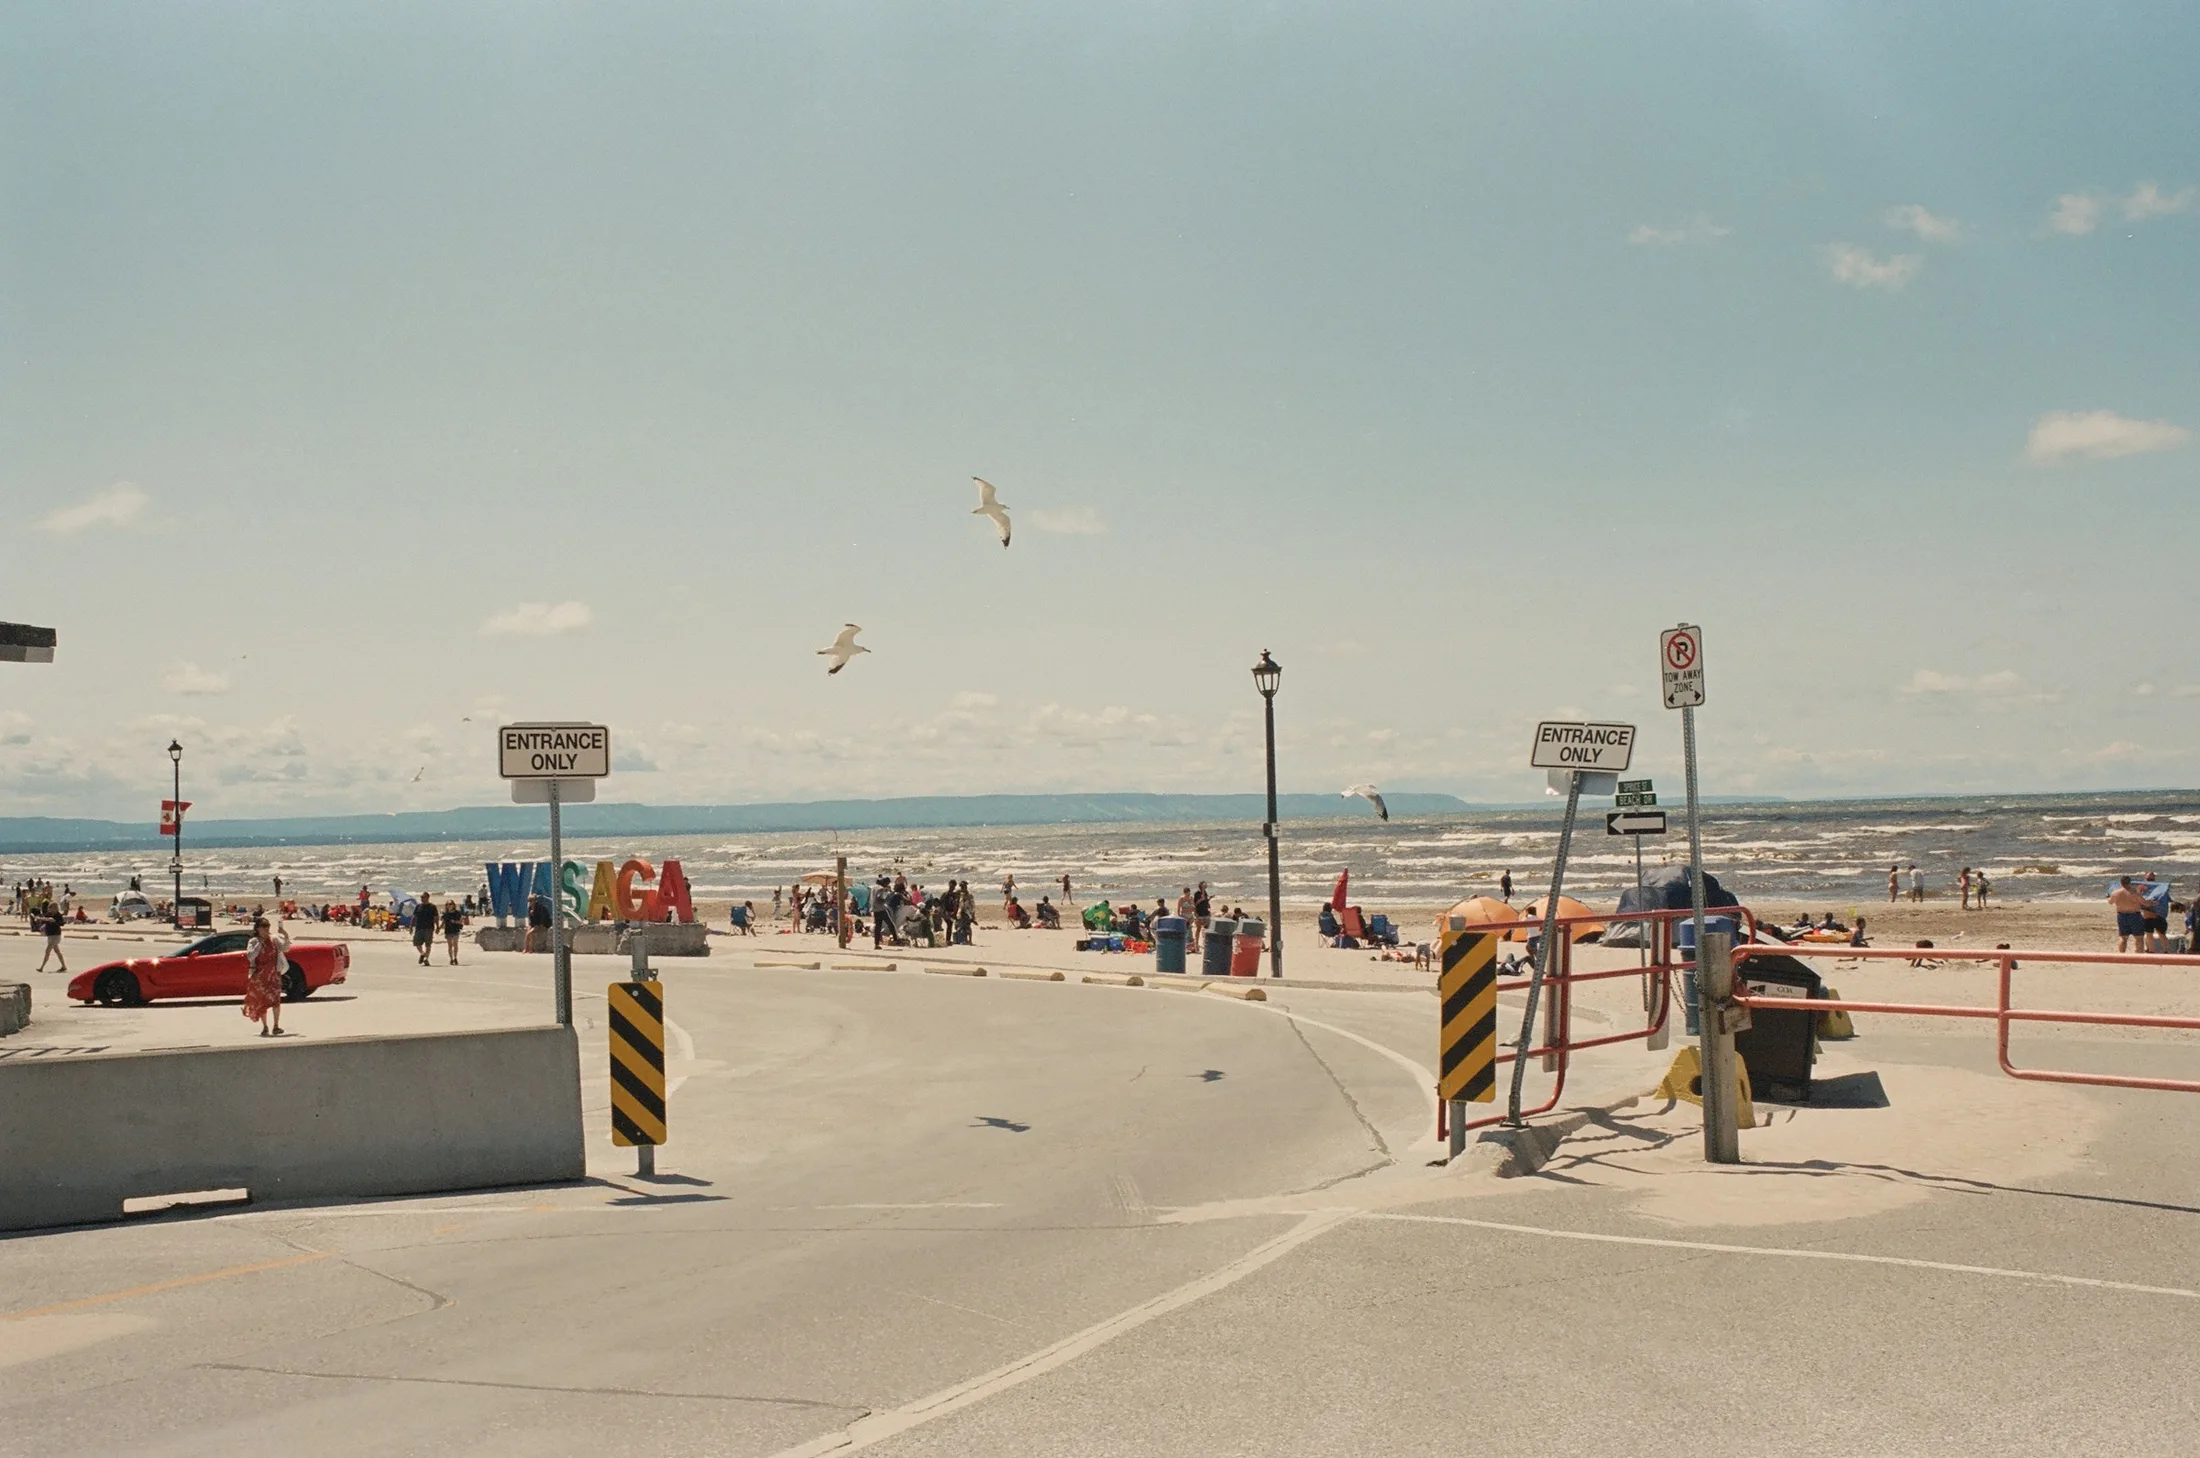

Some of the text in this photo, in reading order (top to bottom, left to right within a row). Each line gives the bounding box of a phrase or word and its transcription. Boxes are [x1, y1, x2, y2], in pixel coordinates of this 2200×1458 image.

[1665, 669, 1701, 682] TOW AWAY
[1674, 681, 1694, 693] ZONE
[506, 733, 603, 750] ENTRANCE
[1541, 728, 1630, 746] ENTRANCE
[531, 754, 578, 770] ONLY
[1560, 747, 1603, 763] ONLY
